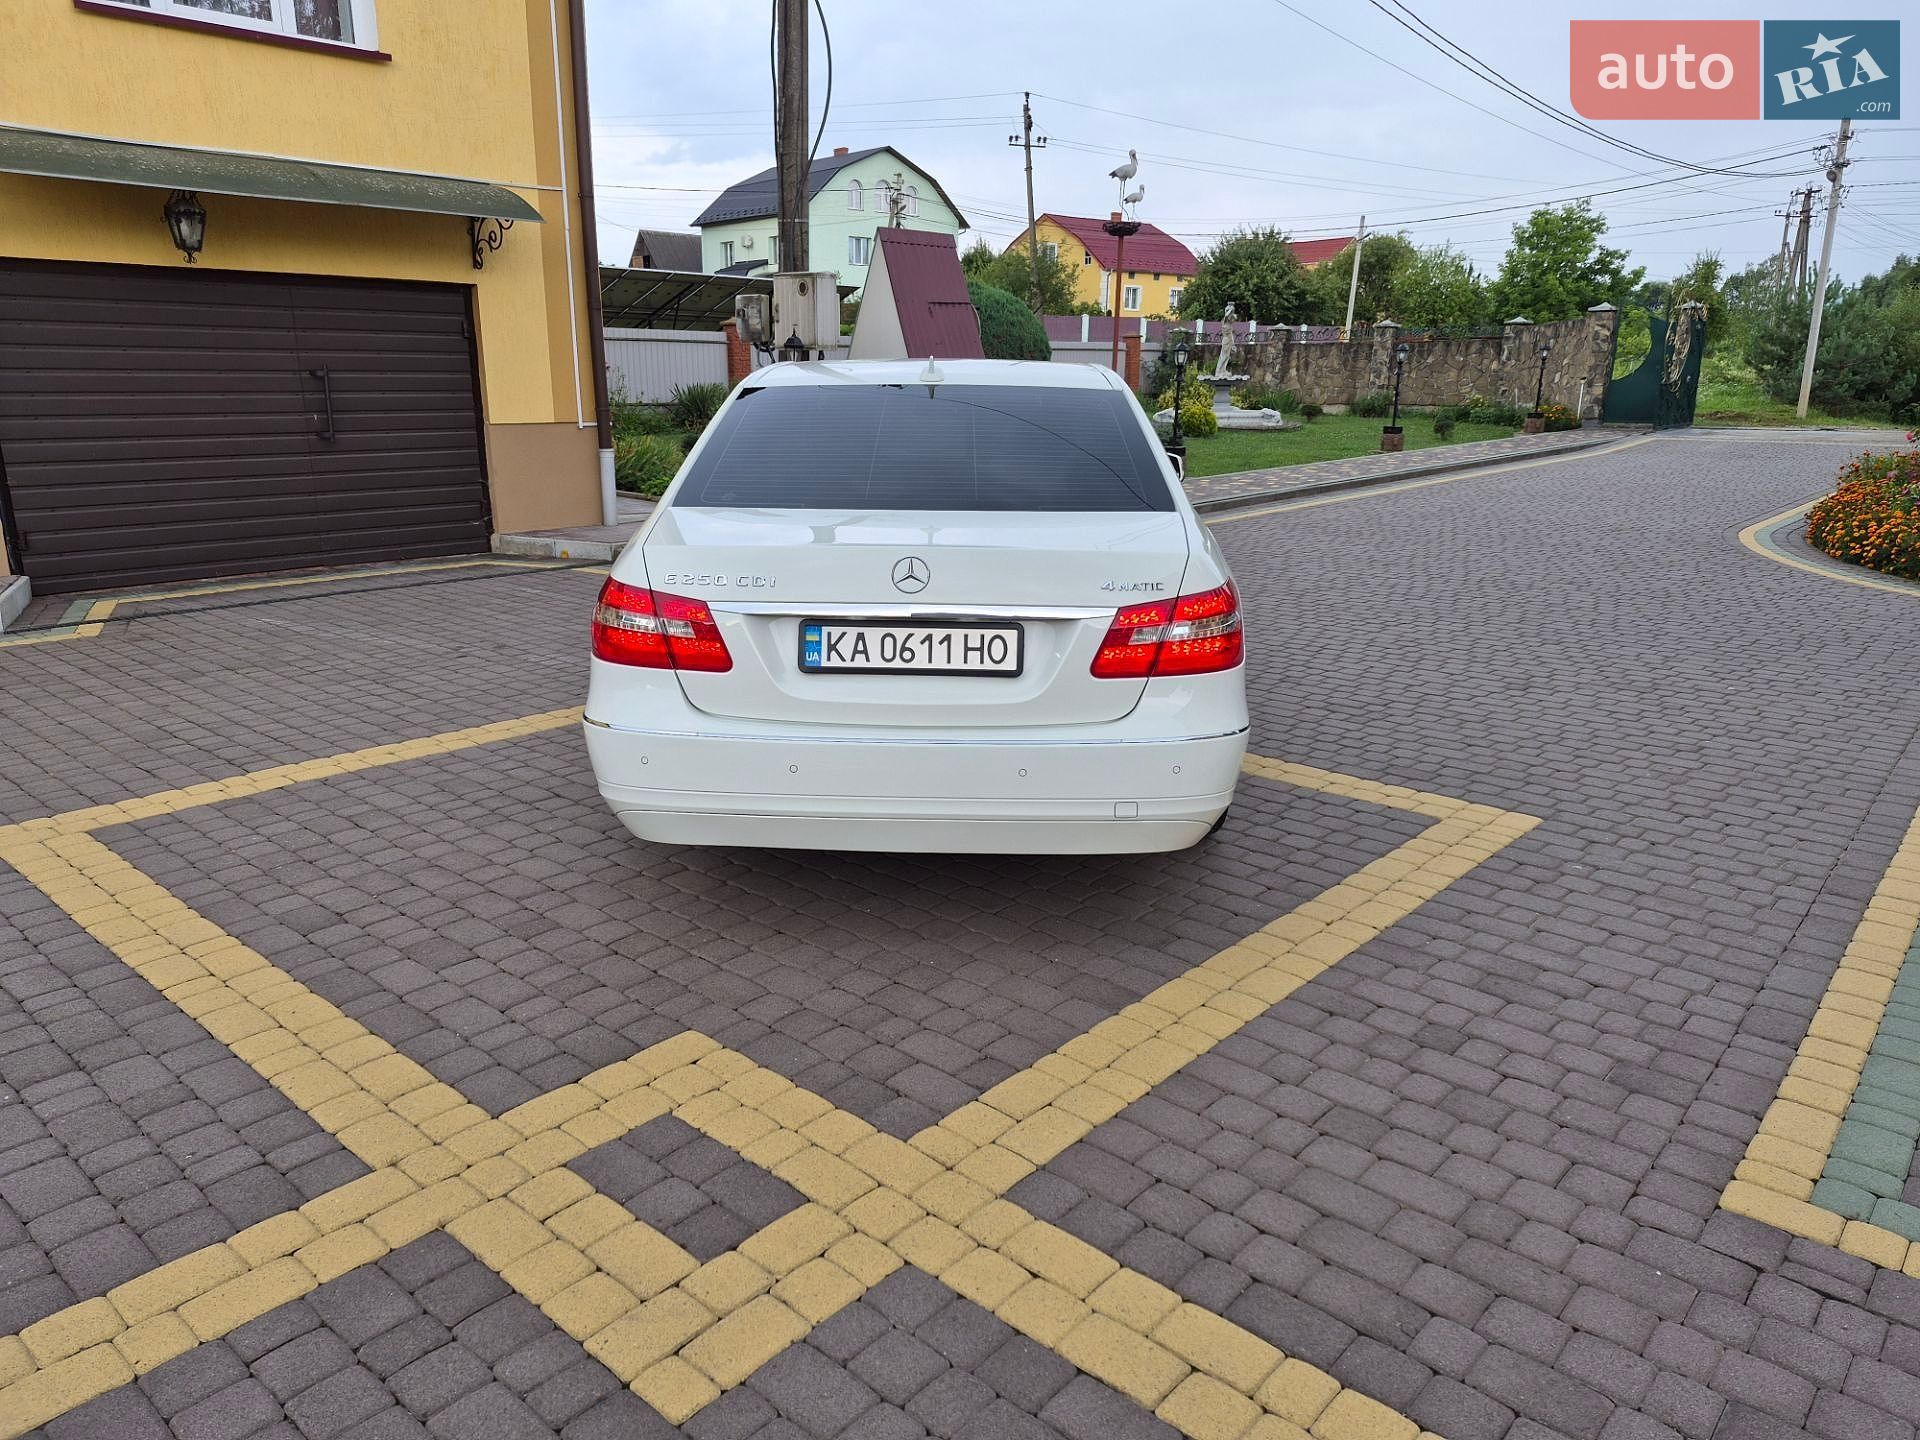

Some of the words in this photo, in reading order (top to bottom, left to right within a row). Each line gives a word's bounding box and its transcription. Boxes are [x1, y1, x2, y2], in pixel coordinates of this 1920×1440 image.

[736, 575, 776, 587] CDI
[826, 631, 870, 663] KA
[880, 632, 952, 664] 0611
[963, 634, 1008, 665] HO
[805, 651, 820, 662] UA
